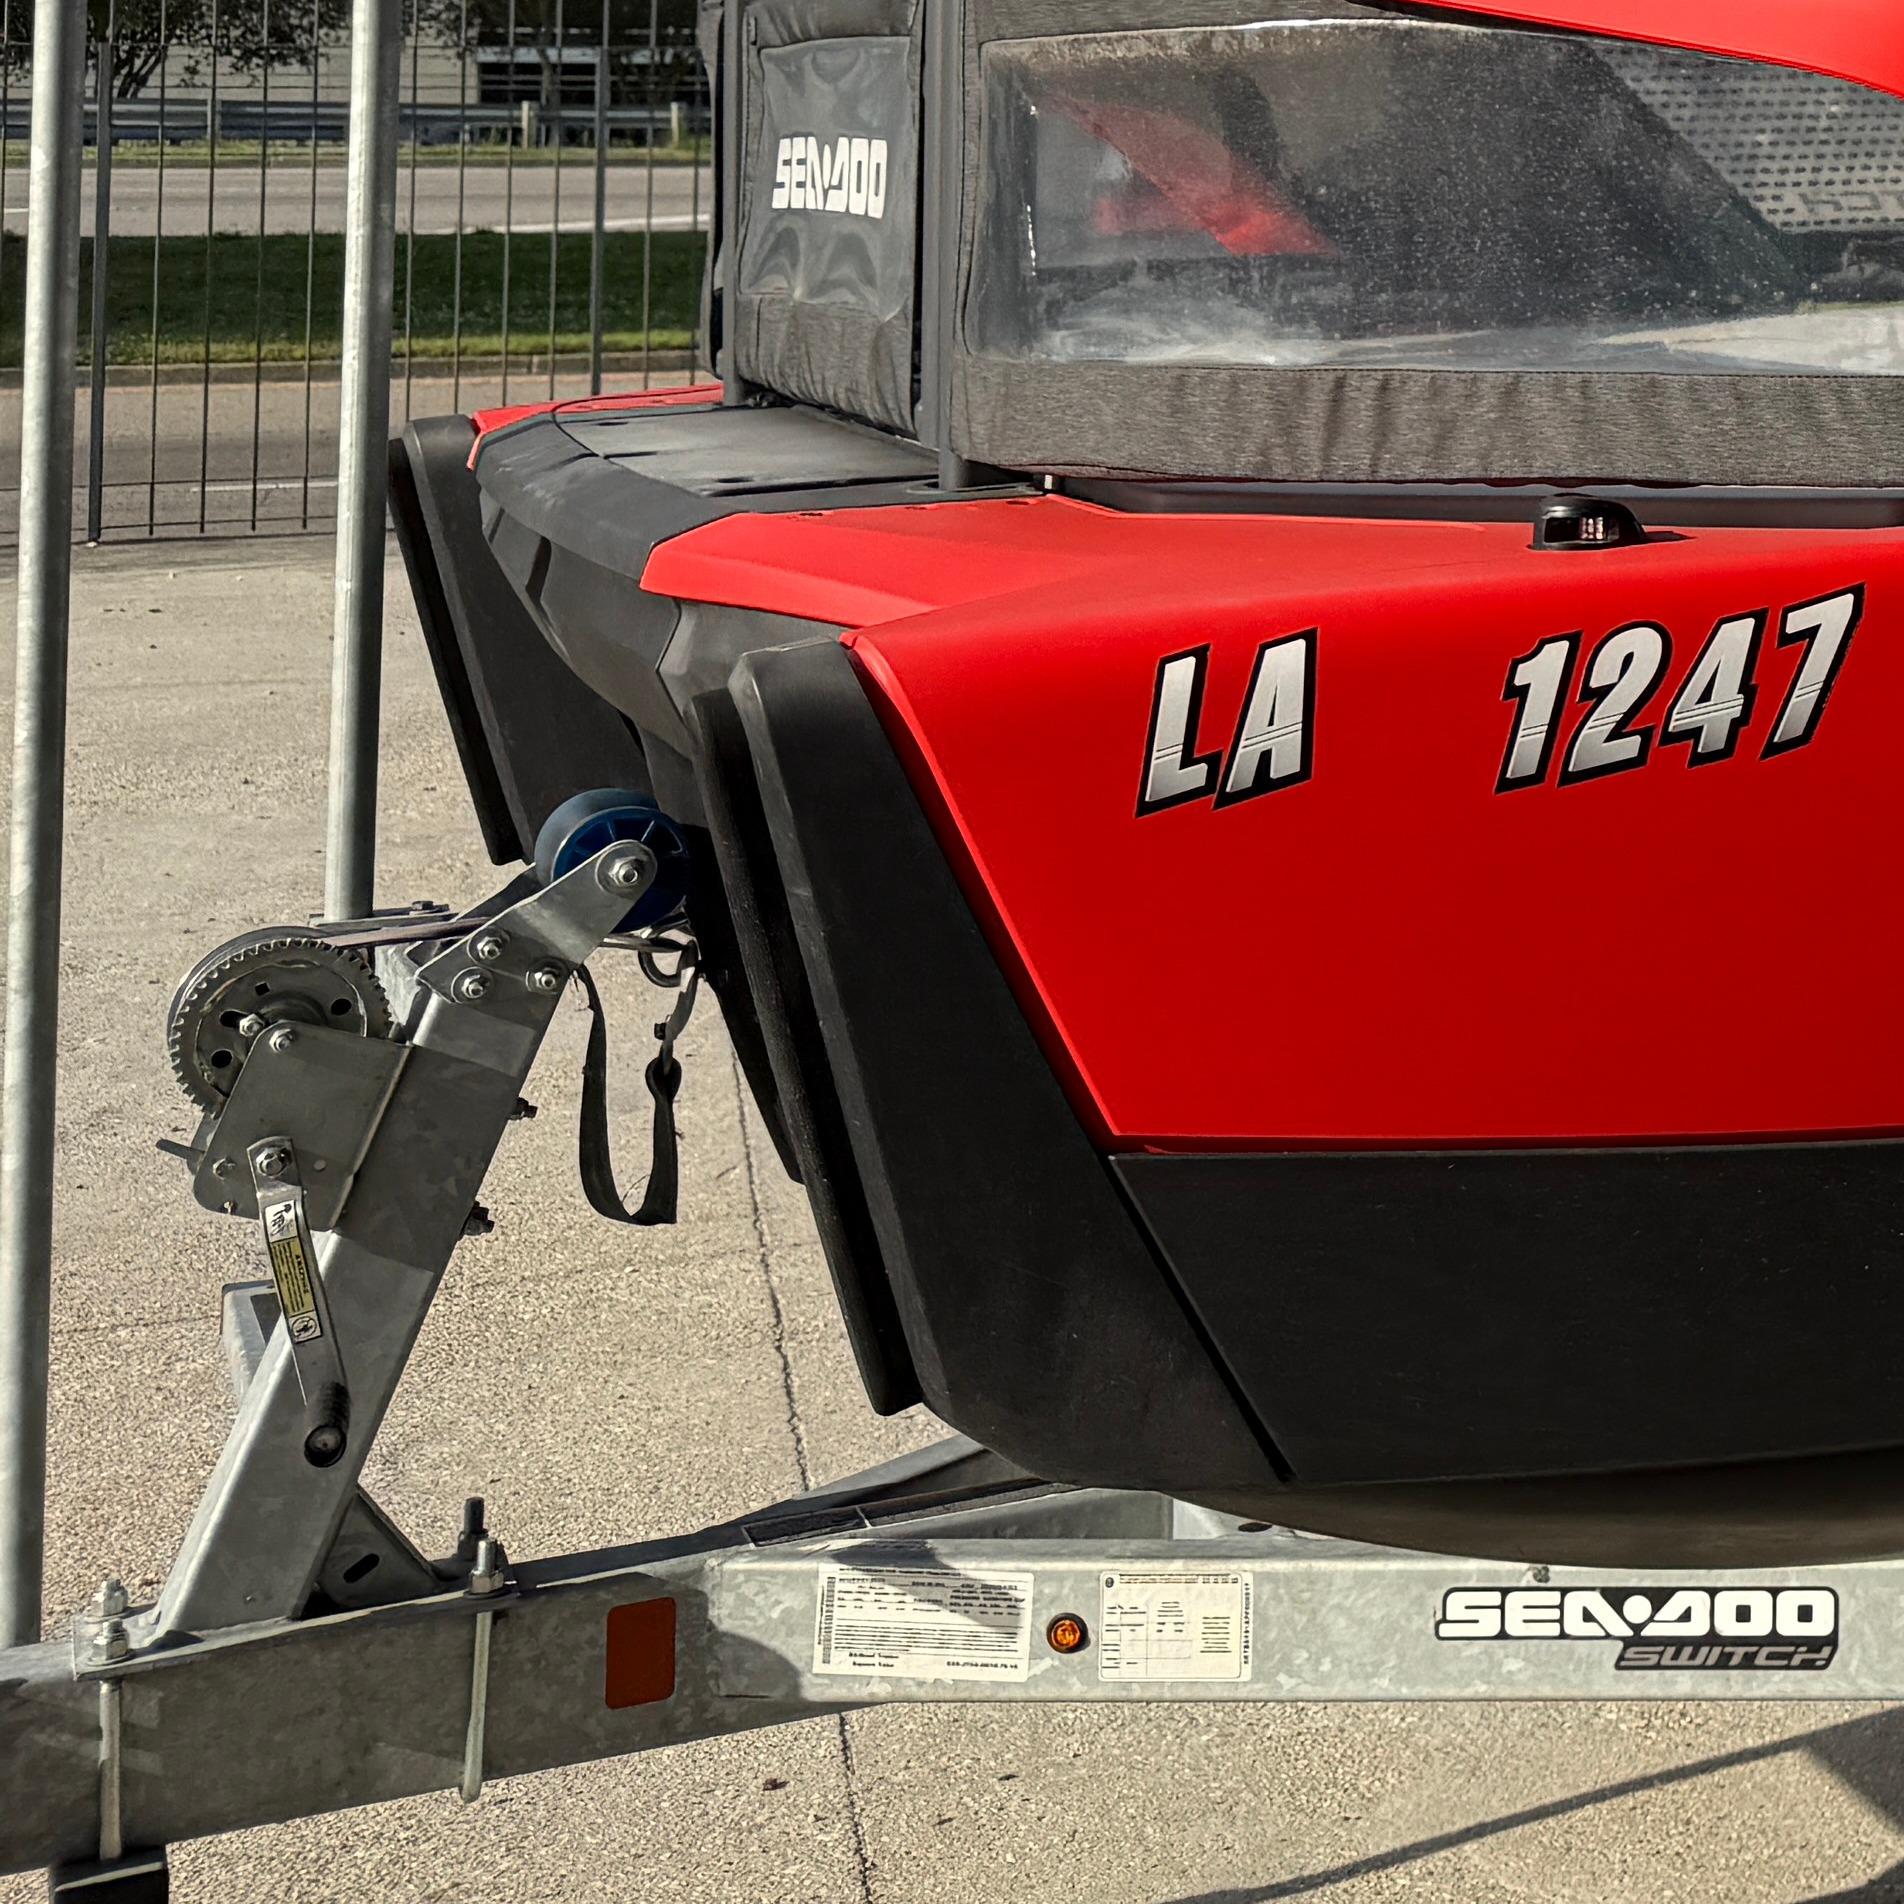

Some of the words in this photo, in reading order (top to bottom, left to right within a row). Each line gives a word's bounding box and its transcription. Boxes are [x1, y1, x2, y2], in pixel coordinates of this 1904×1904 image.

[1134, 627, 1319, 818] LA
[1494, 582, 1866, 795] 1247
[1619, 1645, 1834, 1667] SWITCH
